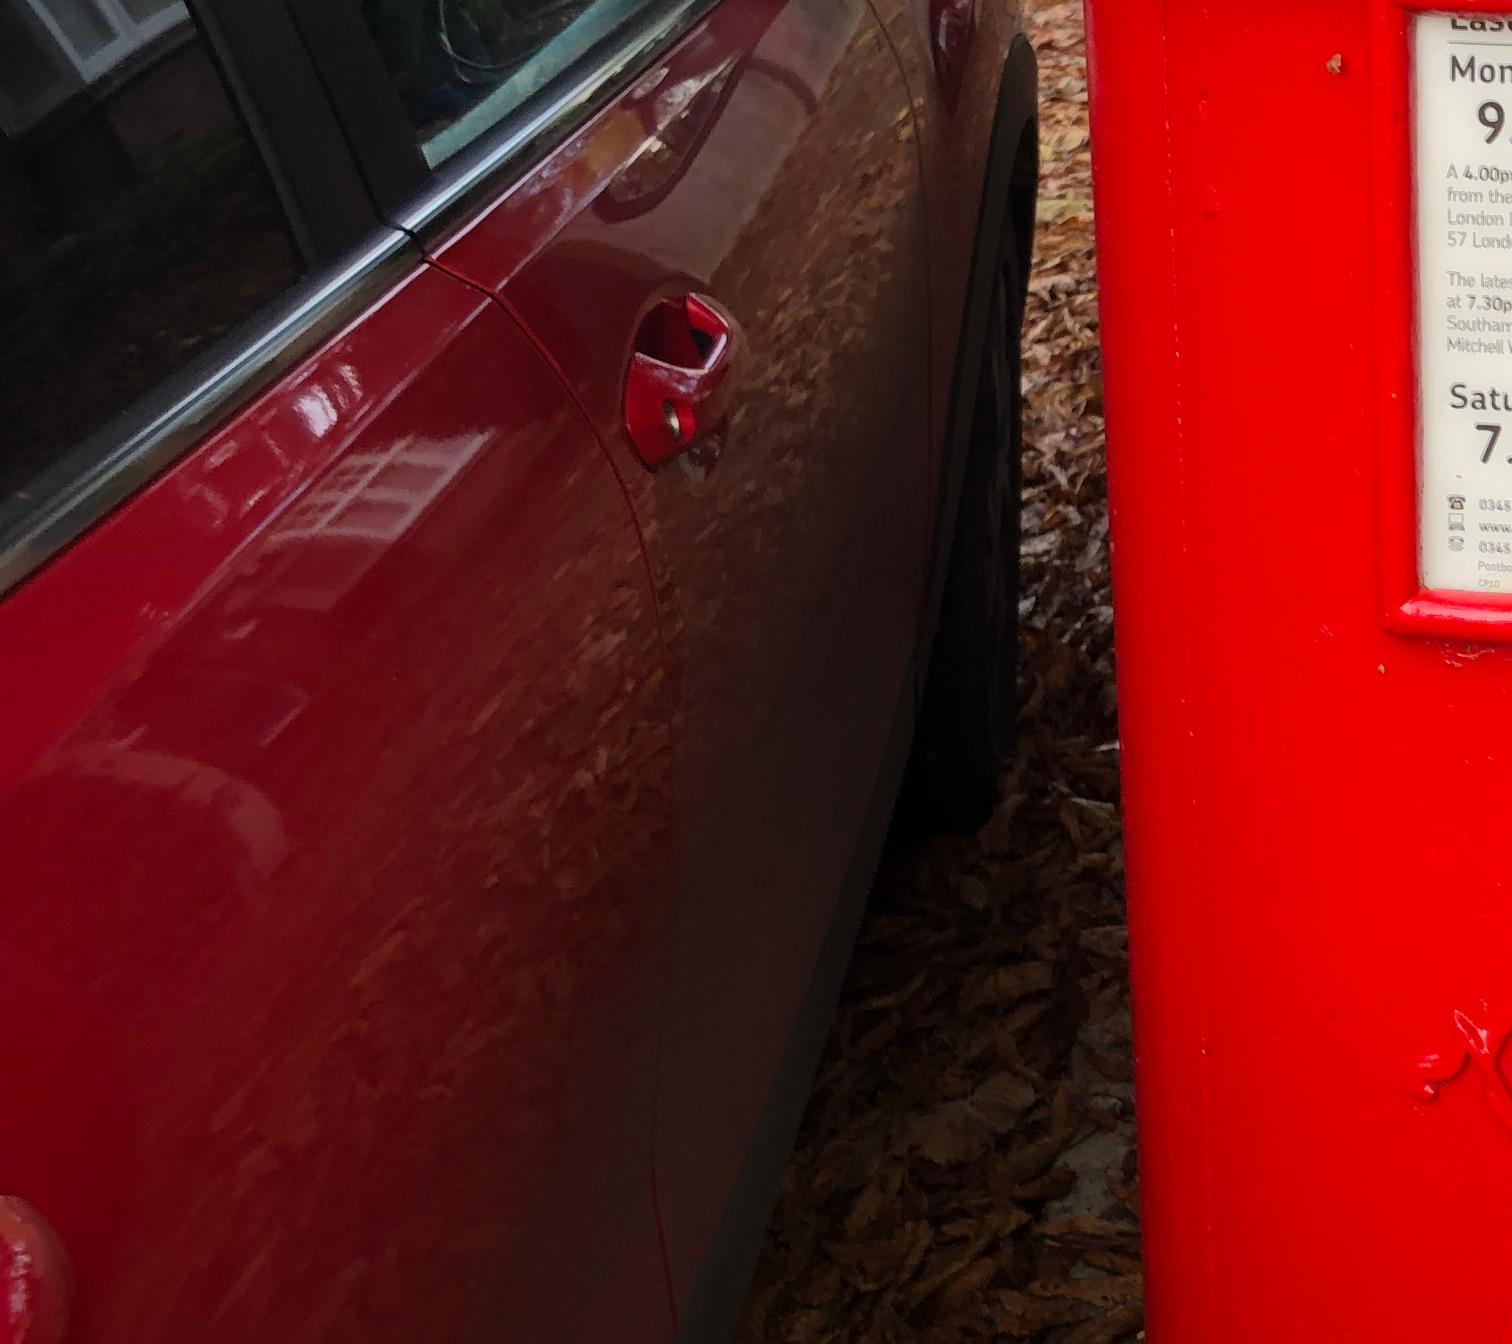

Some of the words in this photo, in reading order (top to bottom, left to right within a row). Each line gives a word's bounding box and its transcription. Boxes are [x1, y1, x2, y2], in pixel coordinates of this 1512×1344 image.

[1446, 164, 1458, 179] A
[1446, 186, 1484, 203] from
[1447, 209, 1505, 226] London
[1447, 231, 1467, 247] 57
[1446, 271, 1476, 288] The
[1446, 295, 1462, 309] at
[1446, 336, 1504, 355] Mitchell
[1478, 540, 1511, 554] 0345
